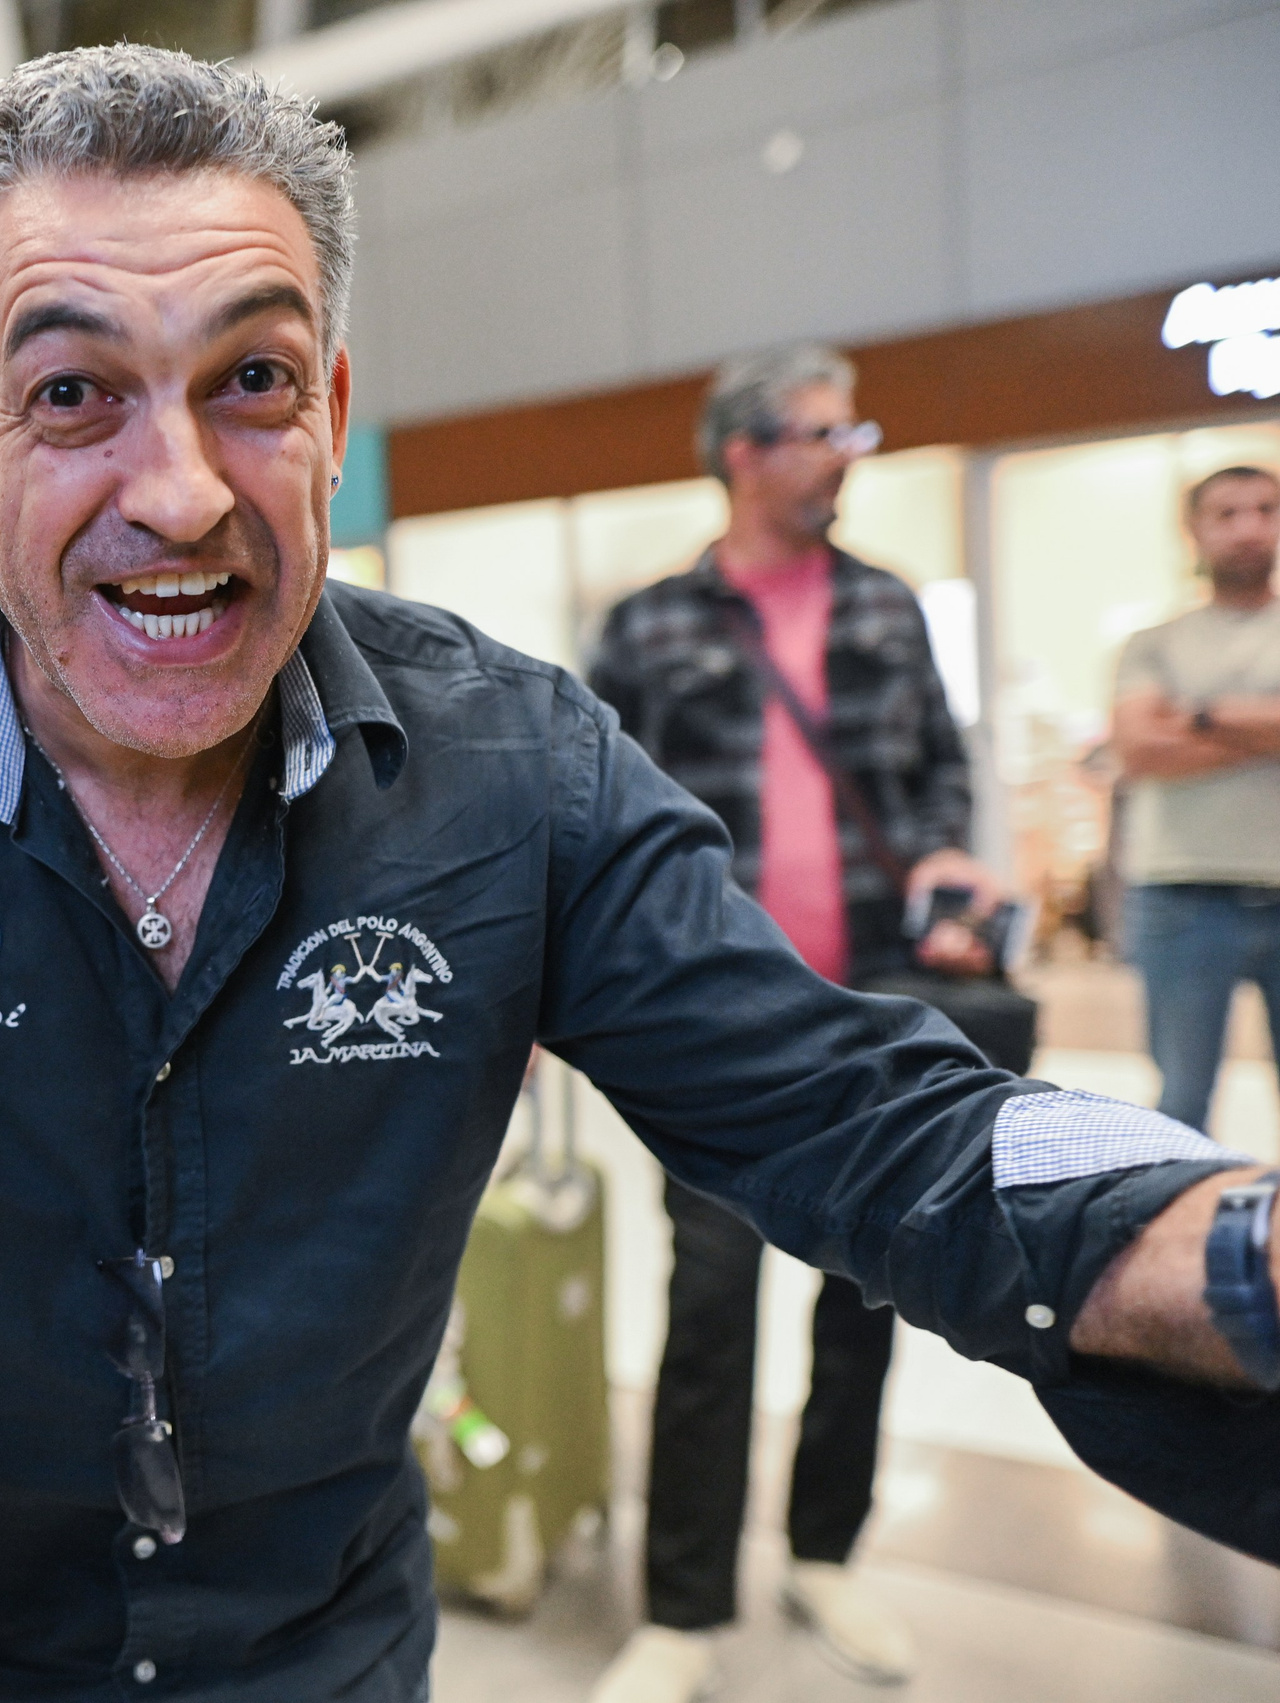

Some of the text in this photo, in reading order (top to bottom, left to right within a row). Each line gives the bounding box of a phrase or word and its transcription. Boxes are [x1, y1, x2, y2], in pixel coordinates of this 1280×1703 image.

[275, 915, 454, 991] TRADICION DEL POLO ARGENTINO
[325, 1040, 441, 1064] MARTINA
